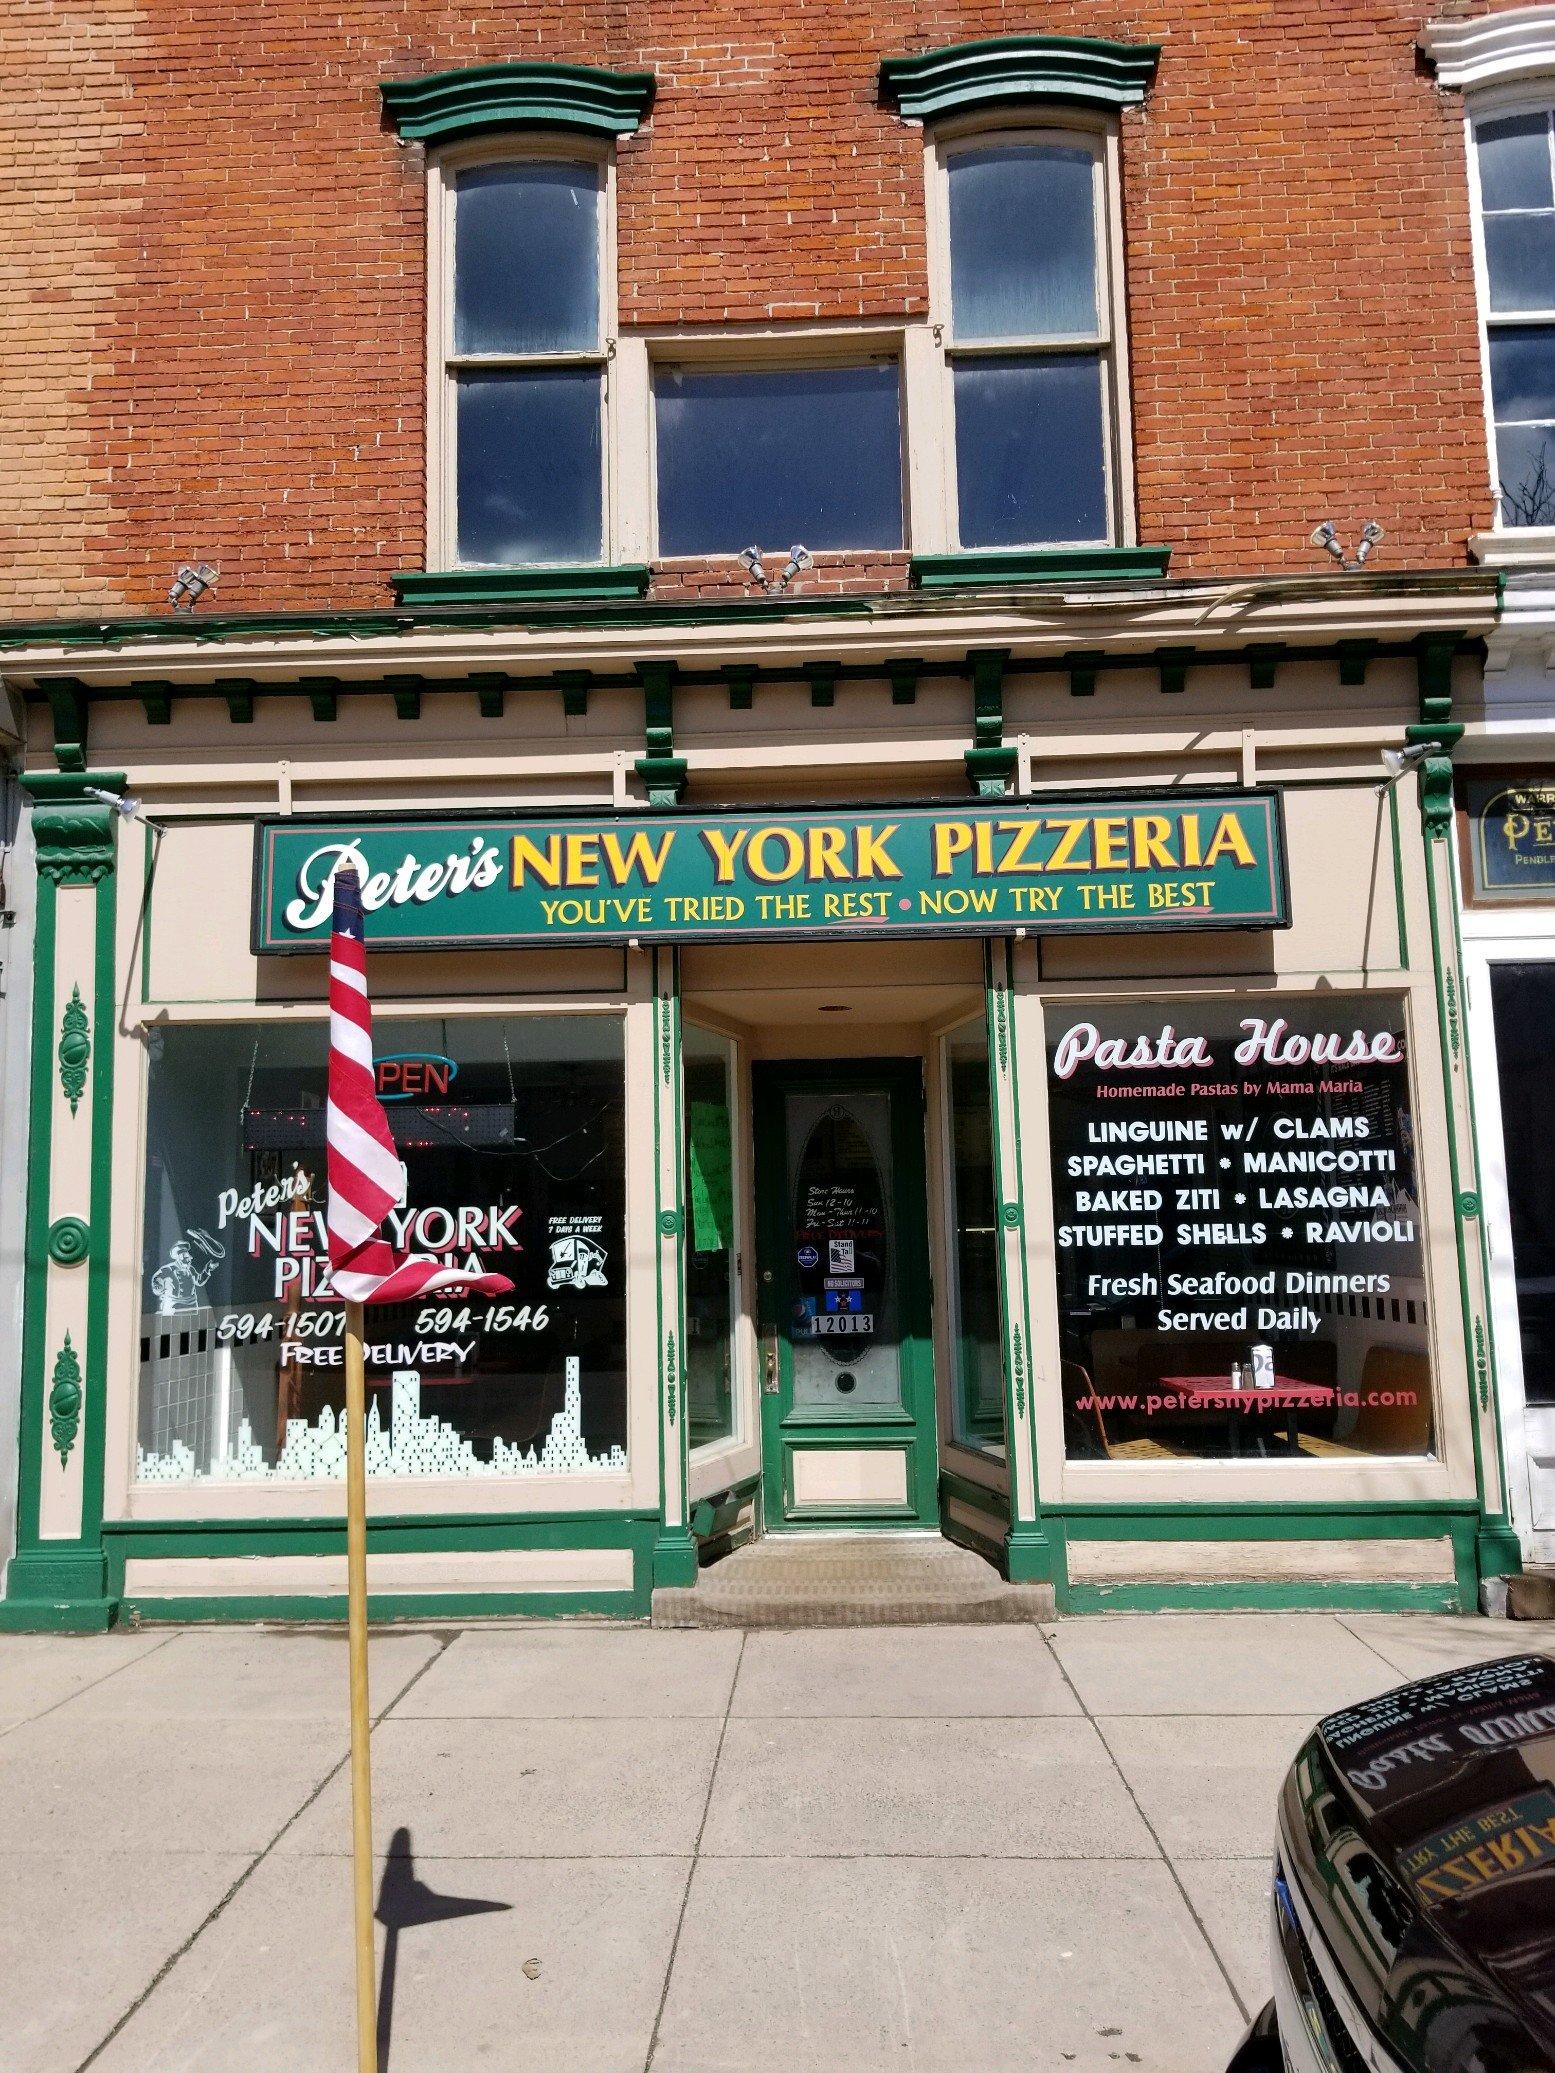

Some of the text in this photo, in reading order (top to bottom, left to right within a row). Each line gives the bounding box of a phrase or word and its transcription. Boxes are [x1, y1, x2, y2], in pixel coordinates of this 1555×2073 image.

[286, 812, 1257, 929] Peter's NEW YORK PIZZERIA
[541, 880, 1216, 926] YOU'VE TRIED THE REST NOW TRY THE BEST
[1053, 1018, 1405, 1080] Pasta House
[378, 1062, 450, 1094] PEN
[1096, 1079, 1364, 1098] Homemade Pastas by Mama Maria
[1088, 1116, 1370, 1143] LINGUINE w/ CLAMS
[1067, 1149, 1396, 1177] SPAGHETTI MANICOTTI
[218, 1160, 311, 1230] Peter's
[1075, 1185, 1391, 1212] BAKED ZITI LASAGNA
[387, 1204, 521, 1251] YORK
[548, 1215, 603, 1225] FREE DELIVERY
[556, 1225, 573, 1234] DAYS
[575, 1225, 581, 1233] A
[582, 1225, 603, 1233] WEEK
[1058, 1220, 1414, 1247] STUFFED SHELLS RAVIOLI
[833, 1240, 853, 1248] Stand
[1088, 1271, 1391, 1296] Fresh Seafood Dinners
[217, 1304, 550, 1341] 594-1507 594-1546
[813, 1315, 872, 1333] 12013
[1157, 1306, 1322, 1334] Served Daily
[280, 1341, 344, 1367] FREE
